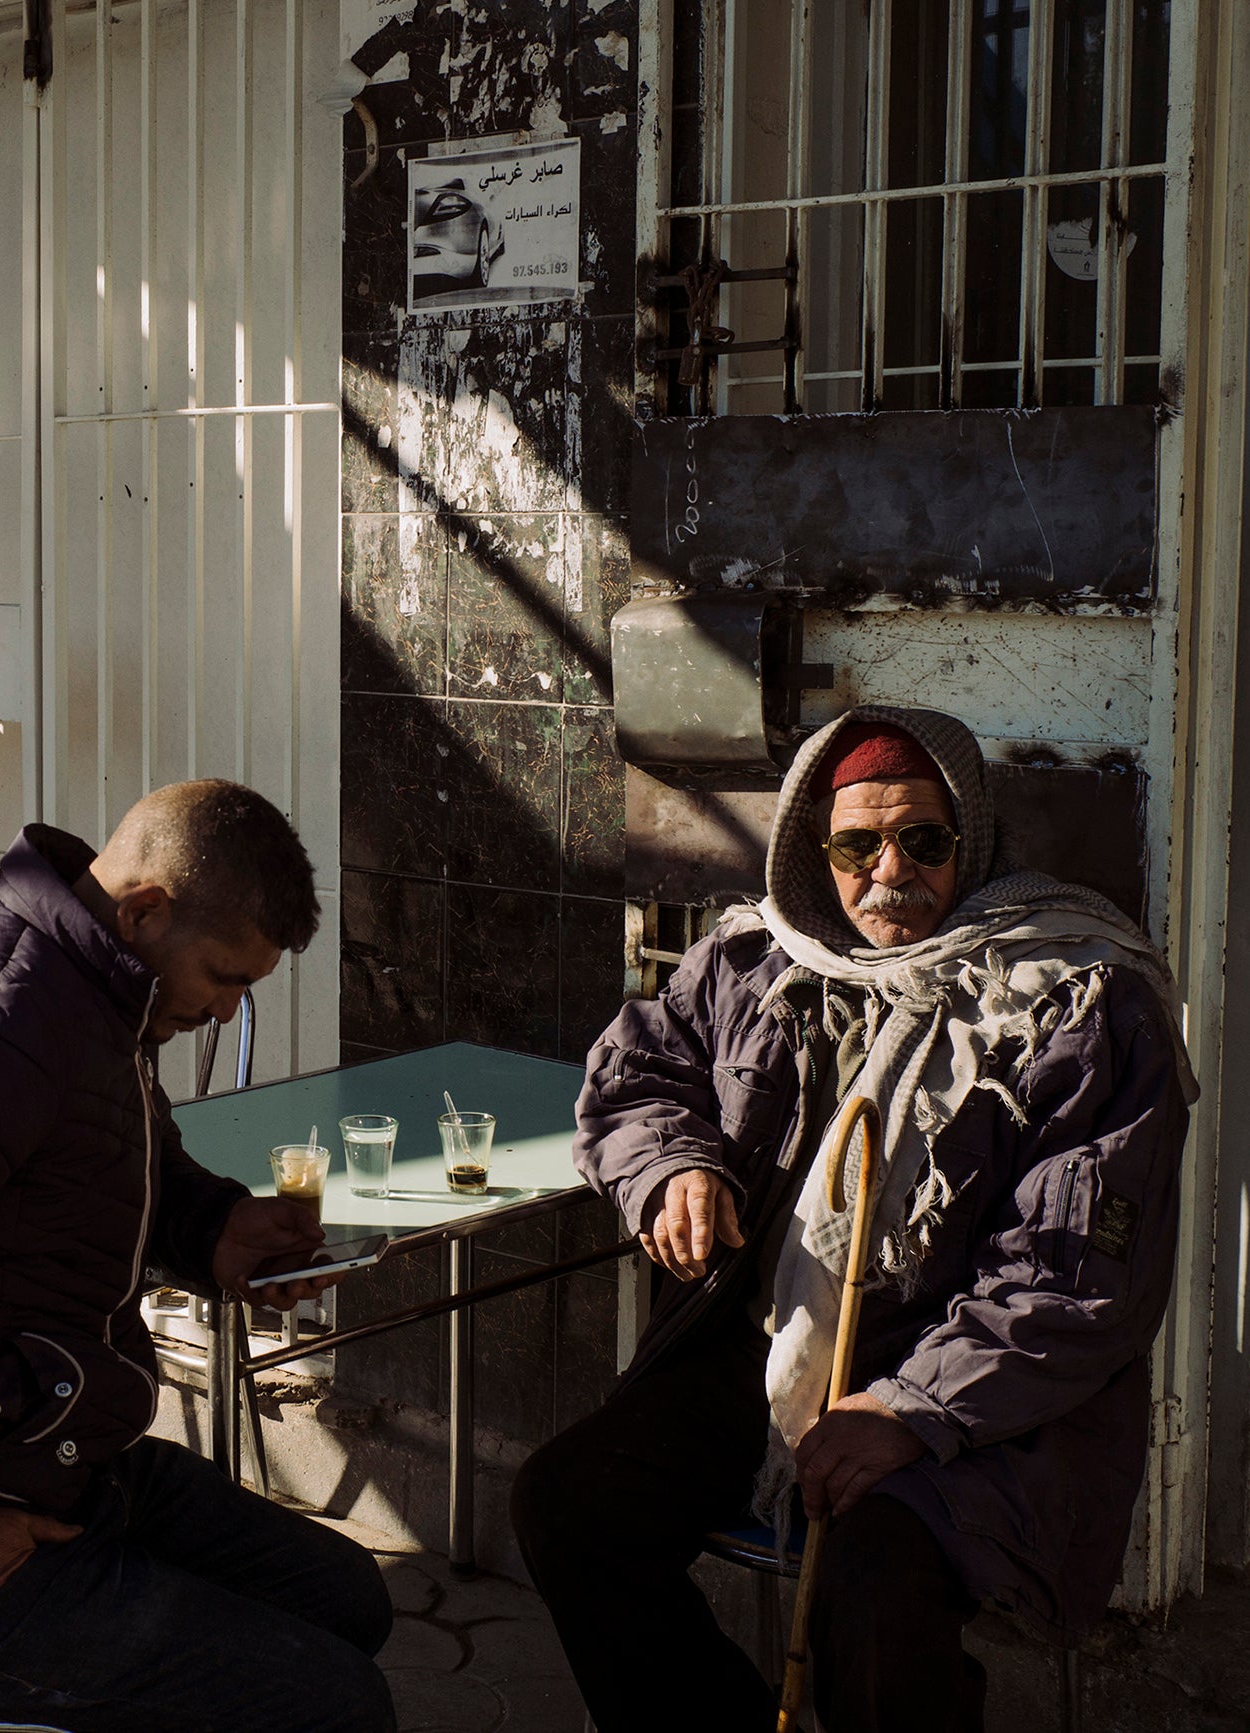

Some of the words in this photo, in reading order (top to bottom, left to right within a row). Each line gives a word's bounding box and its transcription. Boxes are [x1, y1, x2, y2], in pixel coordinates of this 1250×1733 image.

[529, 160, 564, 183] صابر
[505, 205, 543, 222] السيارات
[546, 203, 572, 218] لكراء
[512, 261, 569, 278] 97.545.193
